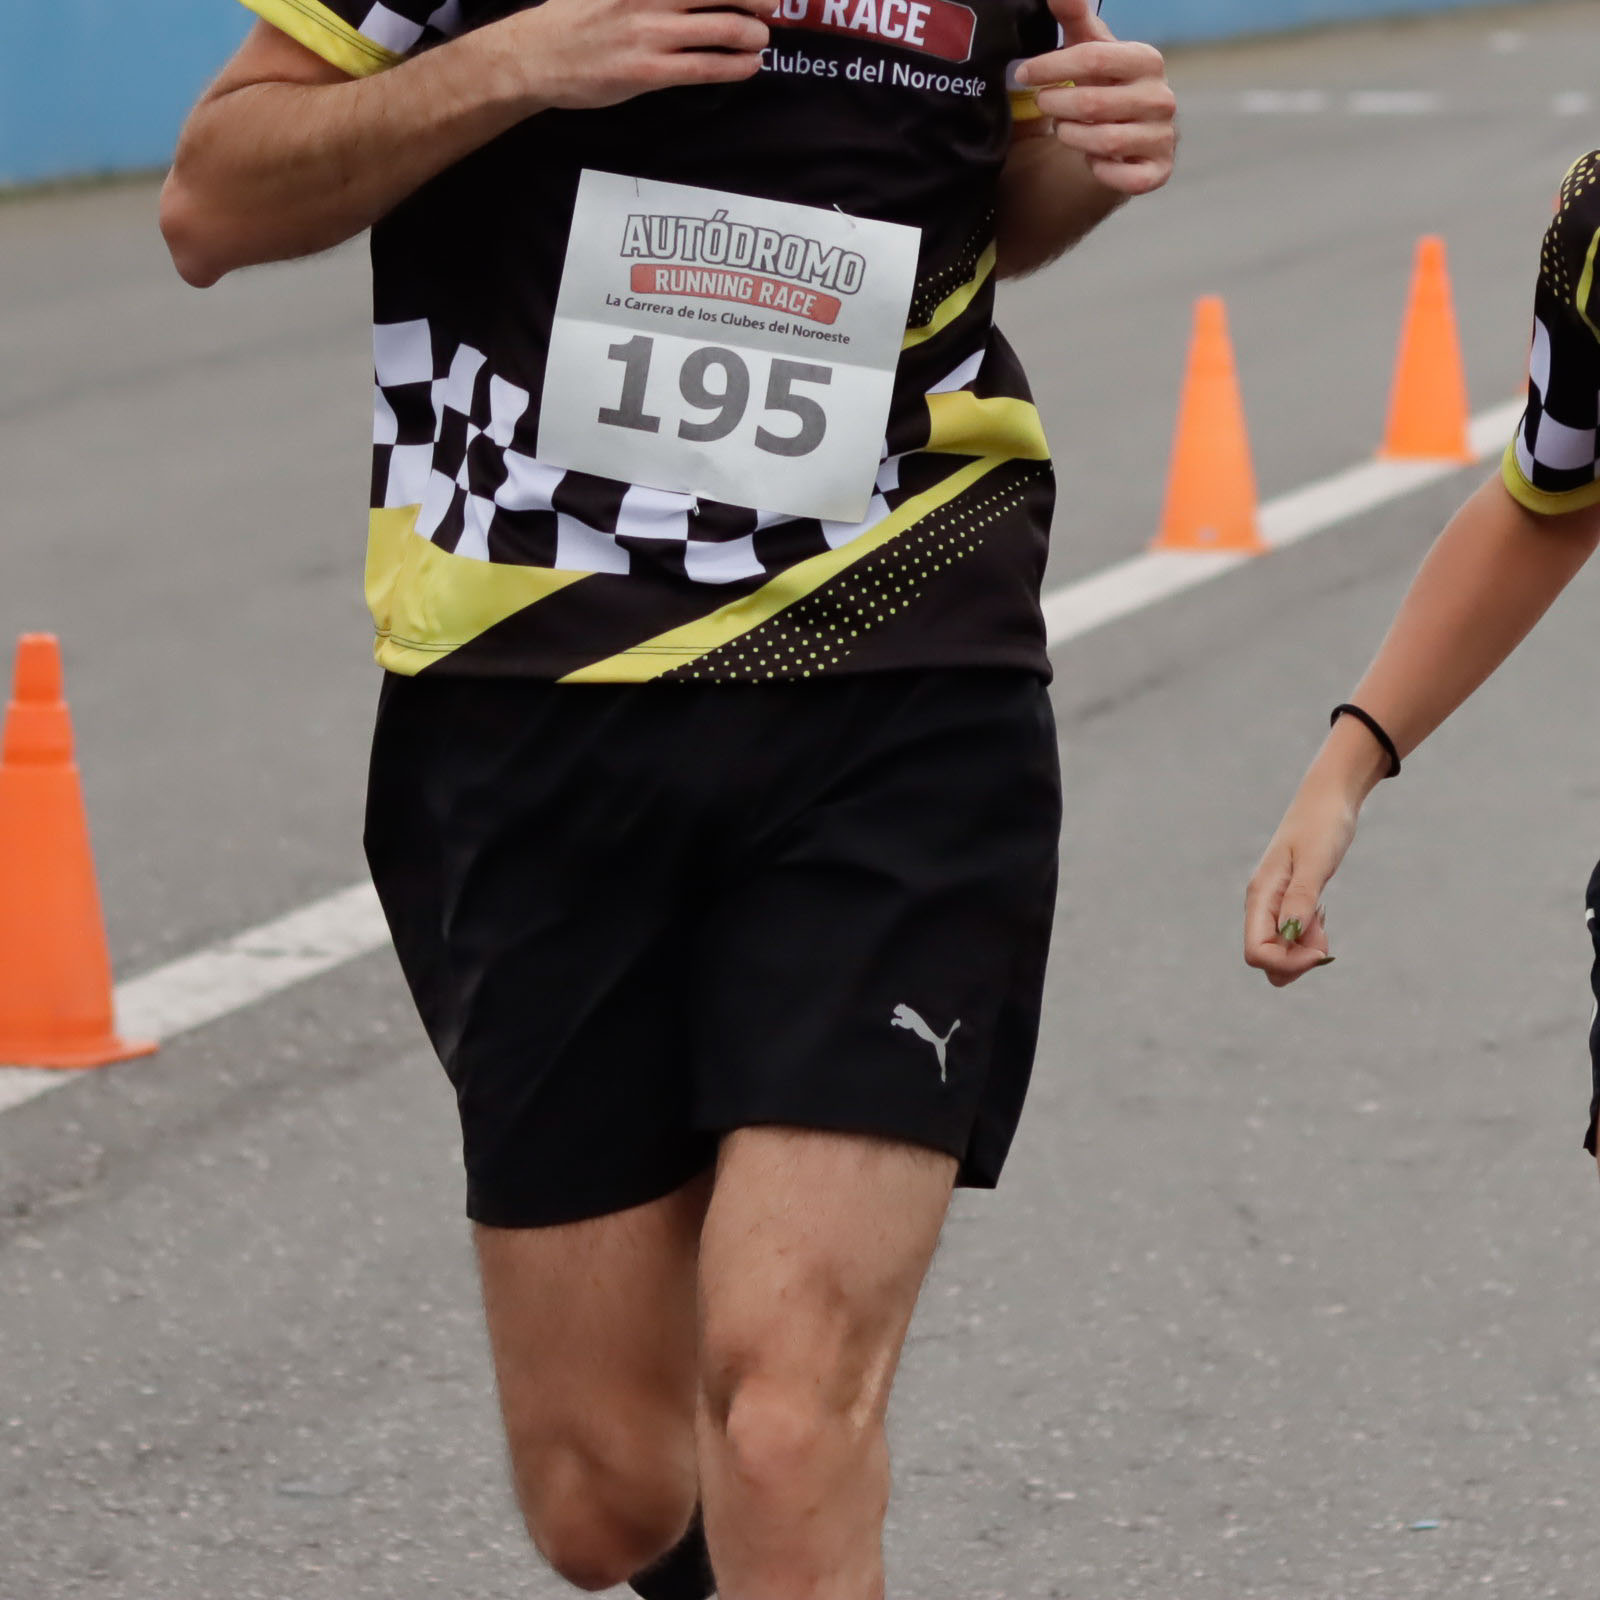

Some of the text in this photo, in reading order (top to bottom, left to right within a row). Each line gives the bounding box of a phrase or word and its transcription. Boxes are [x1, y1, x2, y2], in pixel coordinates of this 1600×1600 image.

[759, 48, 987, 97] Clubes del Noroeste
[620, 209, 866, 295] AUTÓDROMO
[655, 269, 817, 316] RUNNING RACE
[606, 293, 850, 345] La Carrera de los Clubes del Noroeste
[597, 334, 834, 458] 195
